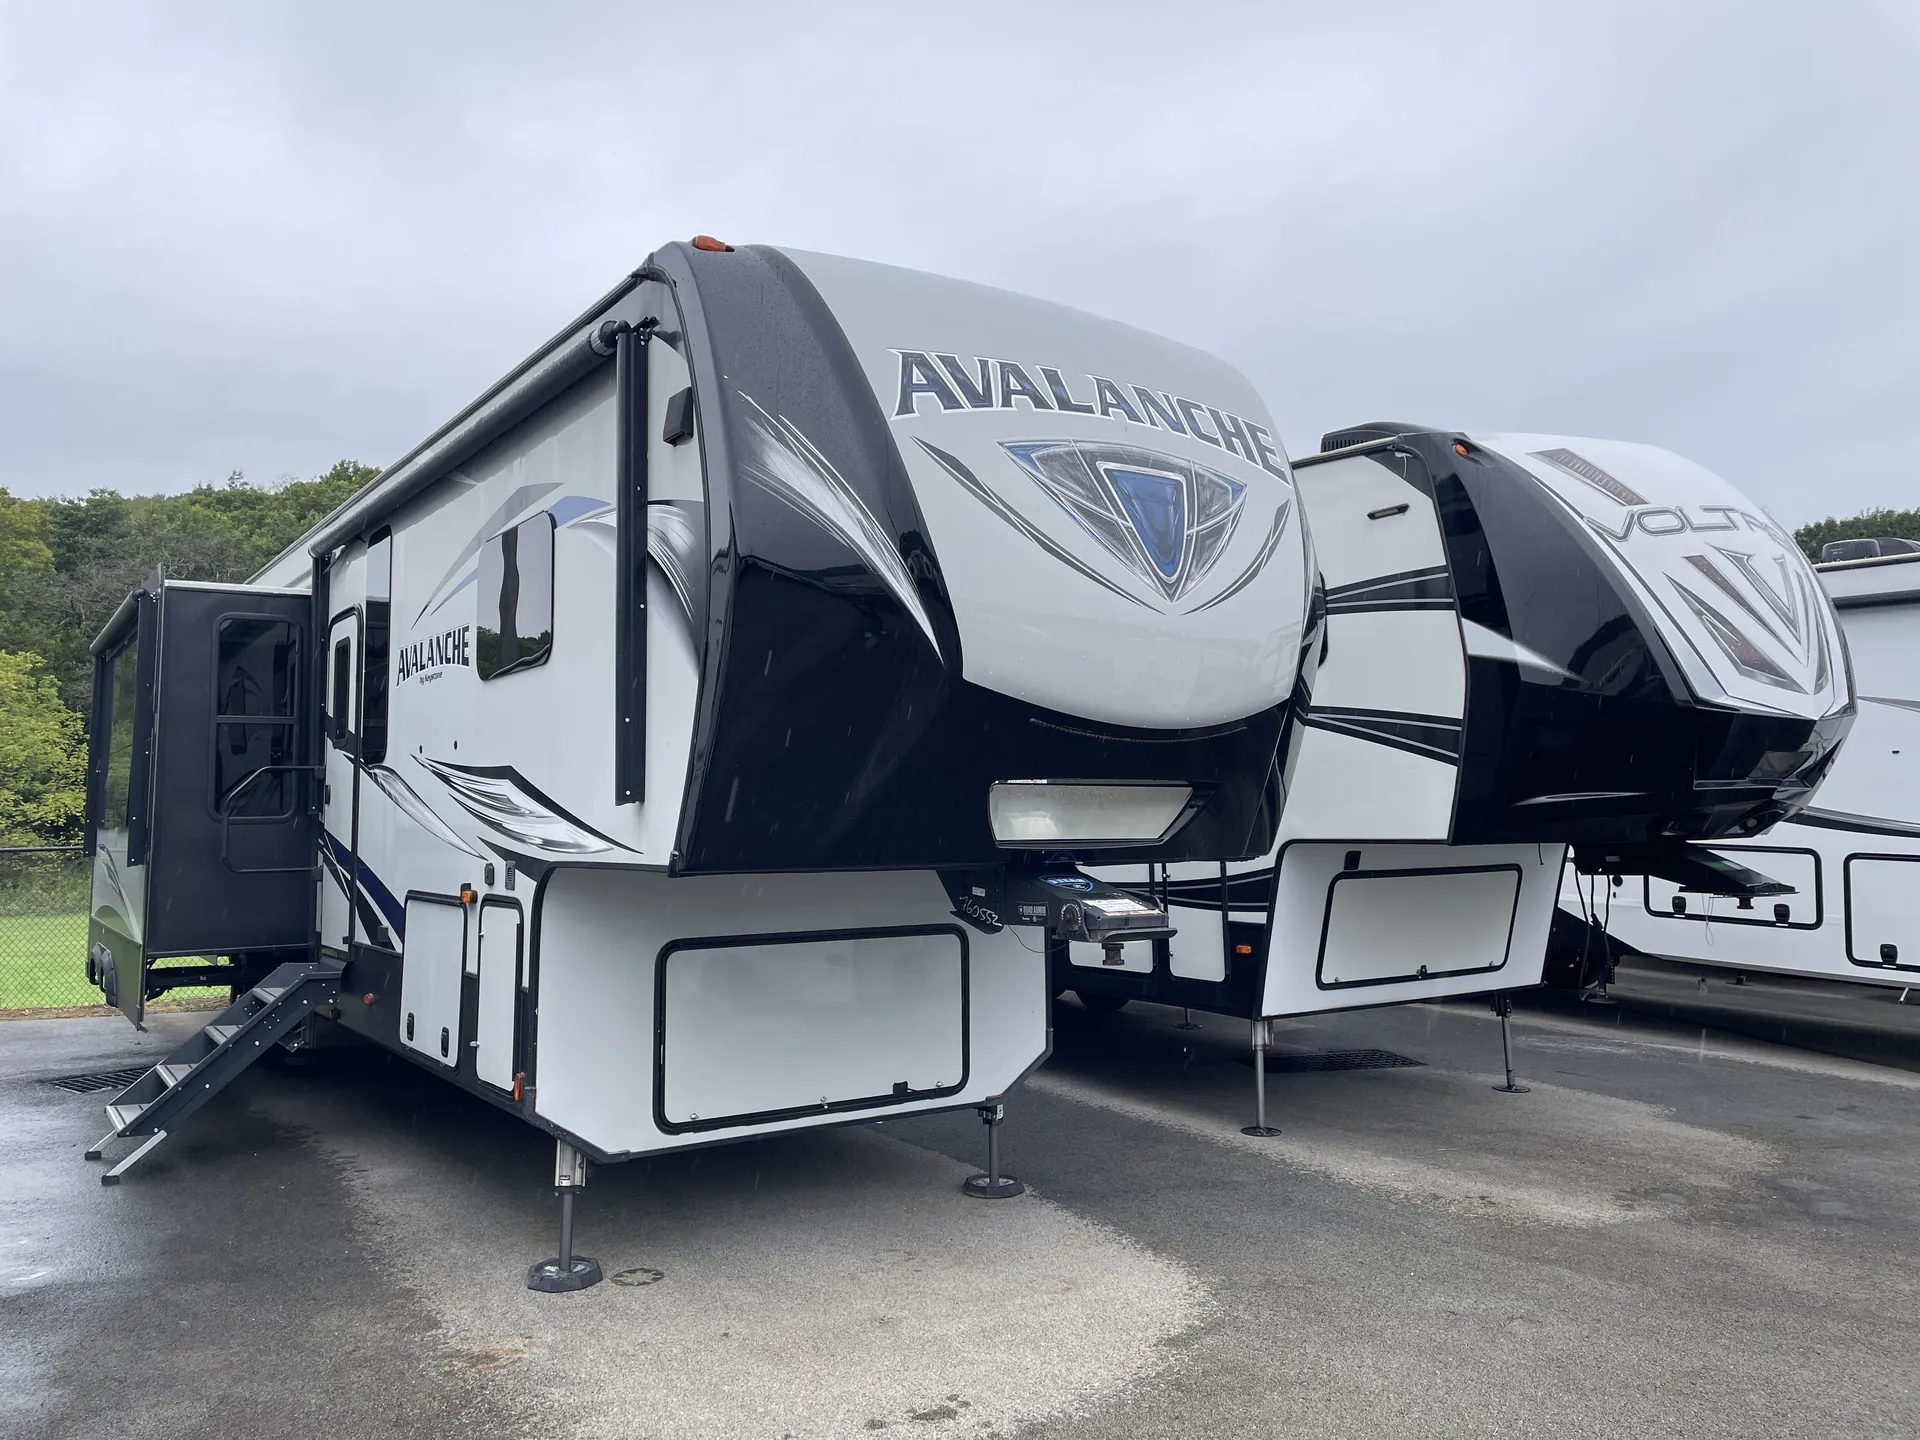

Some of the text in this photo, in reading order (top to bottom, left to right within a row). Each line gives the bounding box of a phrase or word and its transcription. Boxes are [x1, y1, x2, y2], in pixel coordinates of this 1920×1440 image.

[886, 347, 1293, 488] AVALANCHE
[396, 624, 470, 687] AVALANCHE
[959, 896, 1003, 927] 760552
